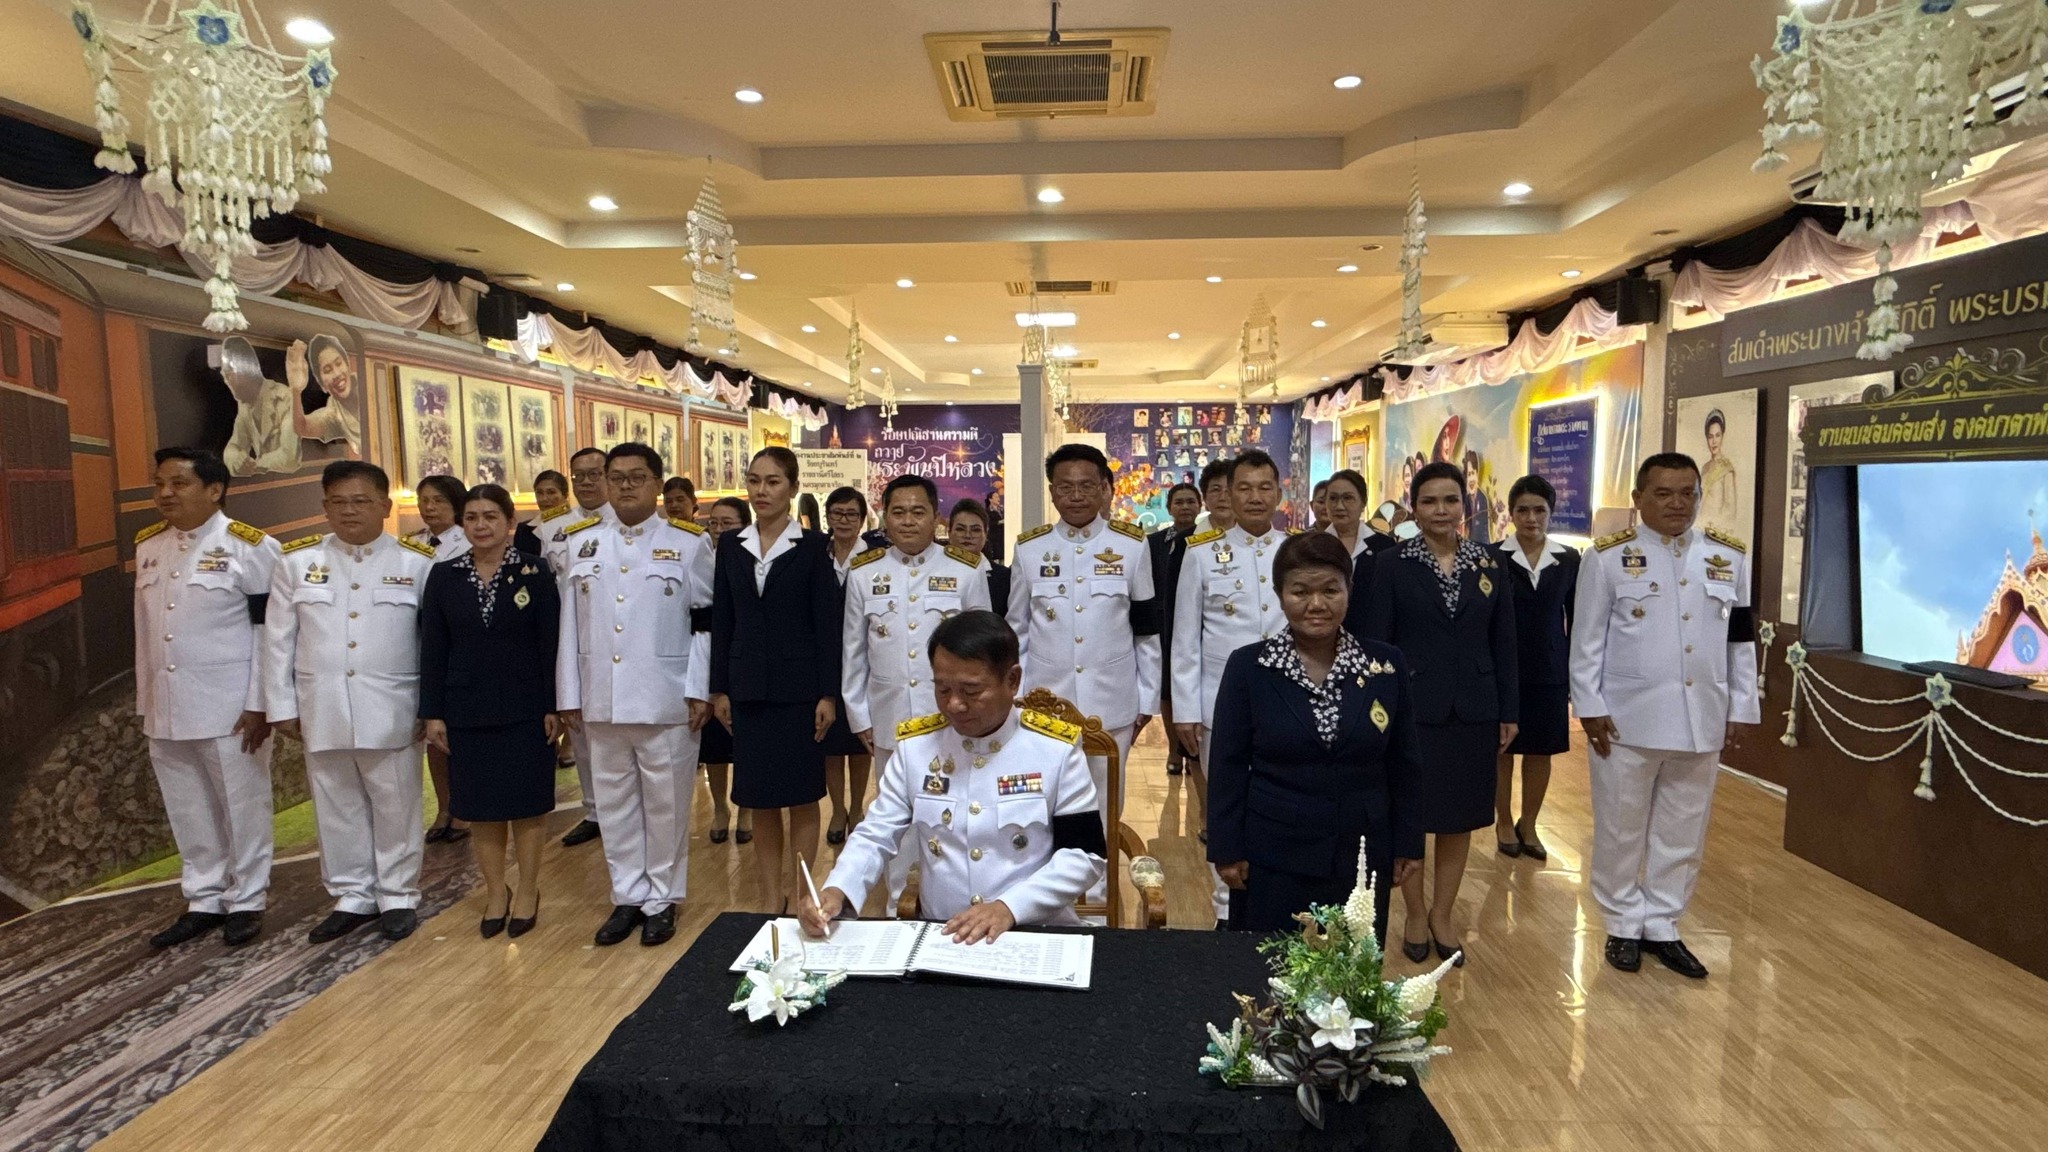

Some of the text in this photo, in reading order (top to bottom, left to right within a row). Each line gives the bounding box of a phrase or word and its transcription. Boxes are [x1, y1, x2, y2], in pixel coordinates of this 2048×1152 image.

[1728, 283, 1944, 364] สมเด็จพระนางเจ้กิติ์
[881, 427, 978, 441] ร้อยปณิธานความดี
[874, 443, 904, 462] ถวาย
